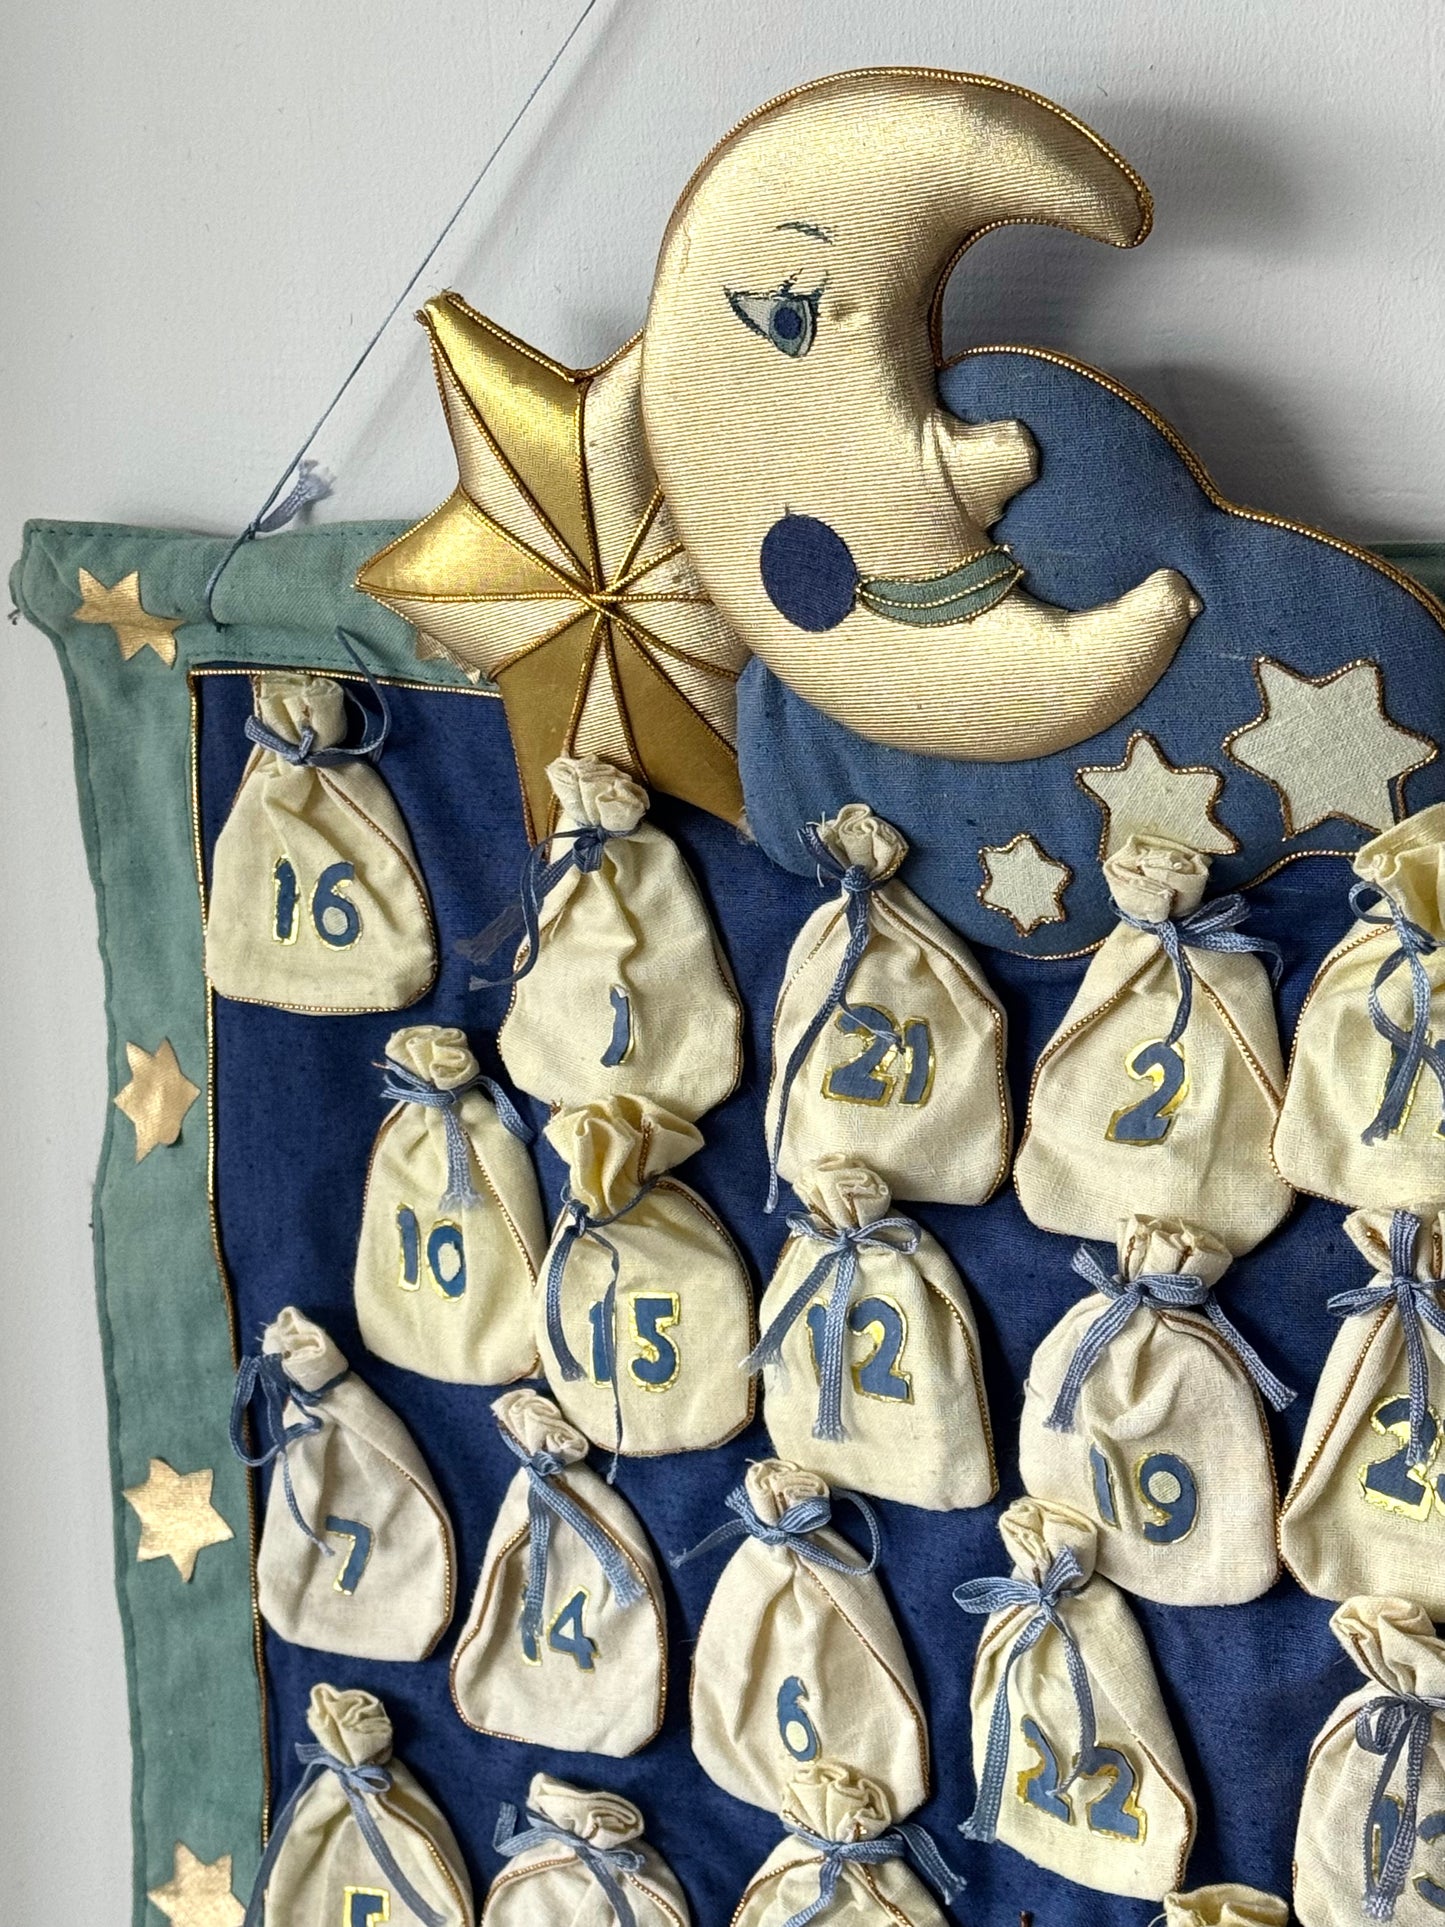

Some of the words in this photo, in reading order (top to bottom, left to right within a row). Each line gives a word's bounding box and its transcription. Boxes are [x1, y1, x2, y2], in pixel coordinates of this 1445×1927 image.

[272, 853, 362, 951] 16
[600, 985, 634, 1067] 1
[821, 1002, 936, 1108] 21
[1105, 1037, 1193, 1147] 2
[396, 1203, 466, 1302] 10
[588, 1291, 680, 1392] 15
[1088, 1439, 1200, 1545] 19
[1358, 1393, 1445, 1521] 2
[326, 1515, 376, 1596] 7
[776, 1675, 822, 1765] 6
[1015, 1713, 1147, 1844] 22
